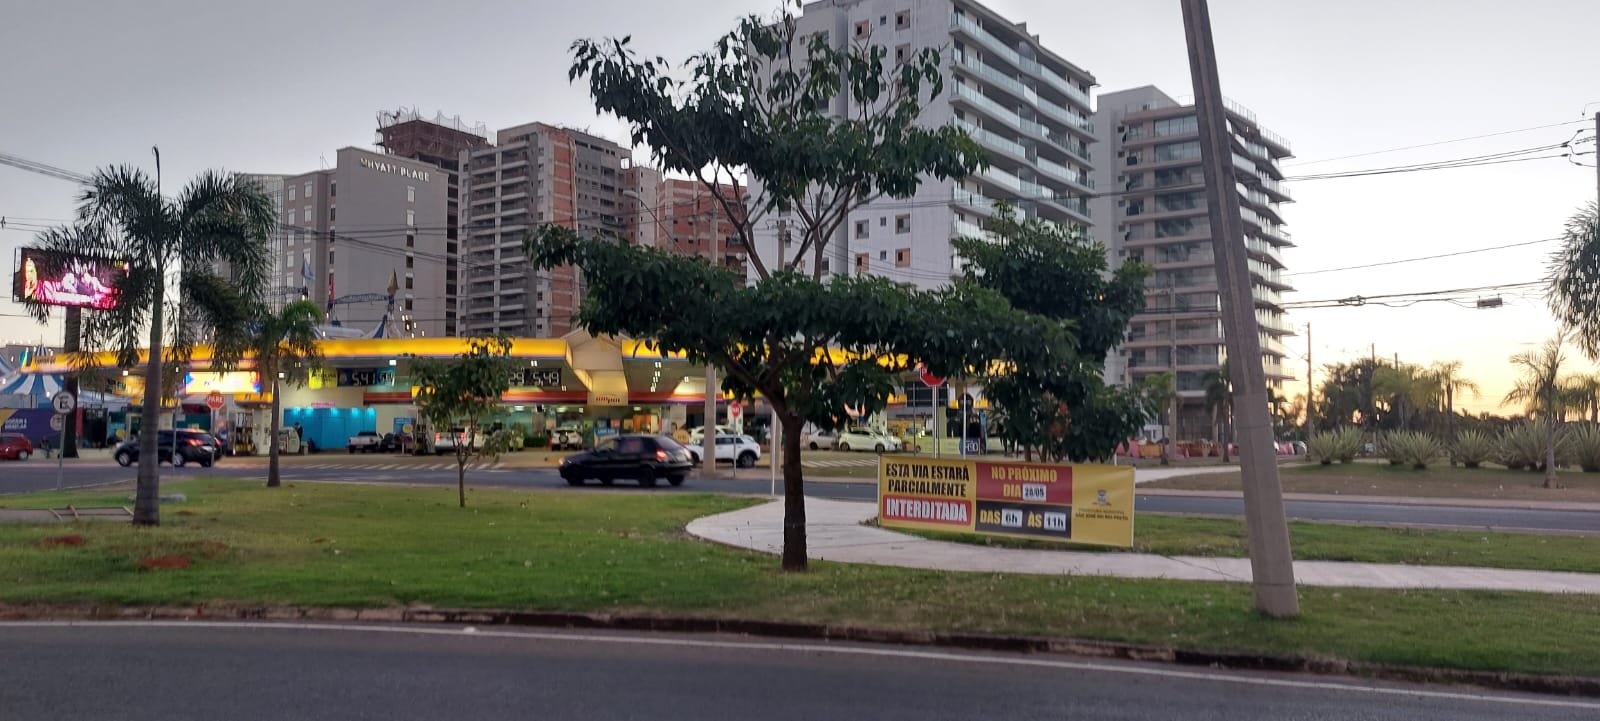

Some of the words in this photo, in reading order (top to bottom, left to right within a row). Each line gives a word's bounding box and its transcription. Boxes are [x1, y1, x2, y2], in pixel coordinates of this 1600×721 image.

[368, 161, 397, 174] HYATT
[400, 166, 430, 182] PLACE
[886, 463, 910, 478] ESTA
[912, 464, 929, 479] VIA
[931, 464, 970, 482] ESTARÁ
[991, 466, 1006, 480] NO
[1007, 466, 1058, 483] PRÓXIMO
[888, 479, 967, 497] PARCIALMENTE
[1003, 483, 1021, 498] DIA
[886, 498, 968, 522] INTERDITADA
[980, 509, 1001, 524] DAS
[1005, 513, 1018, 523] 6h
[1027, 511, 1042, 528] ÀS
